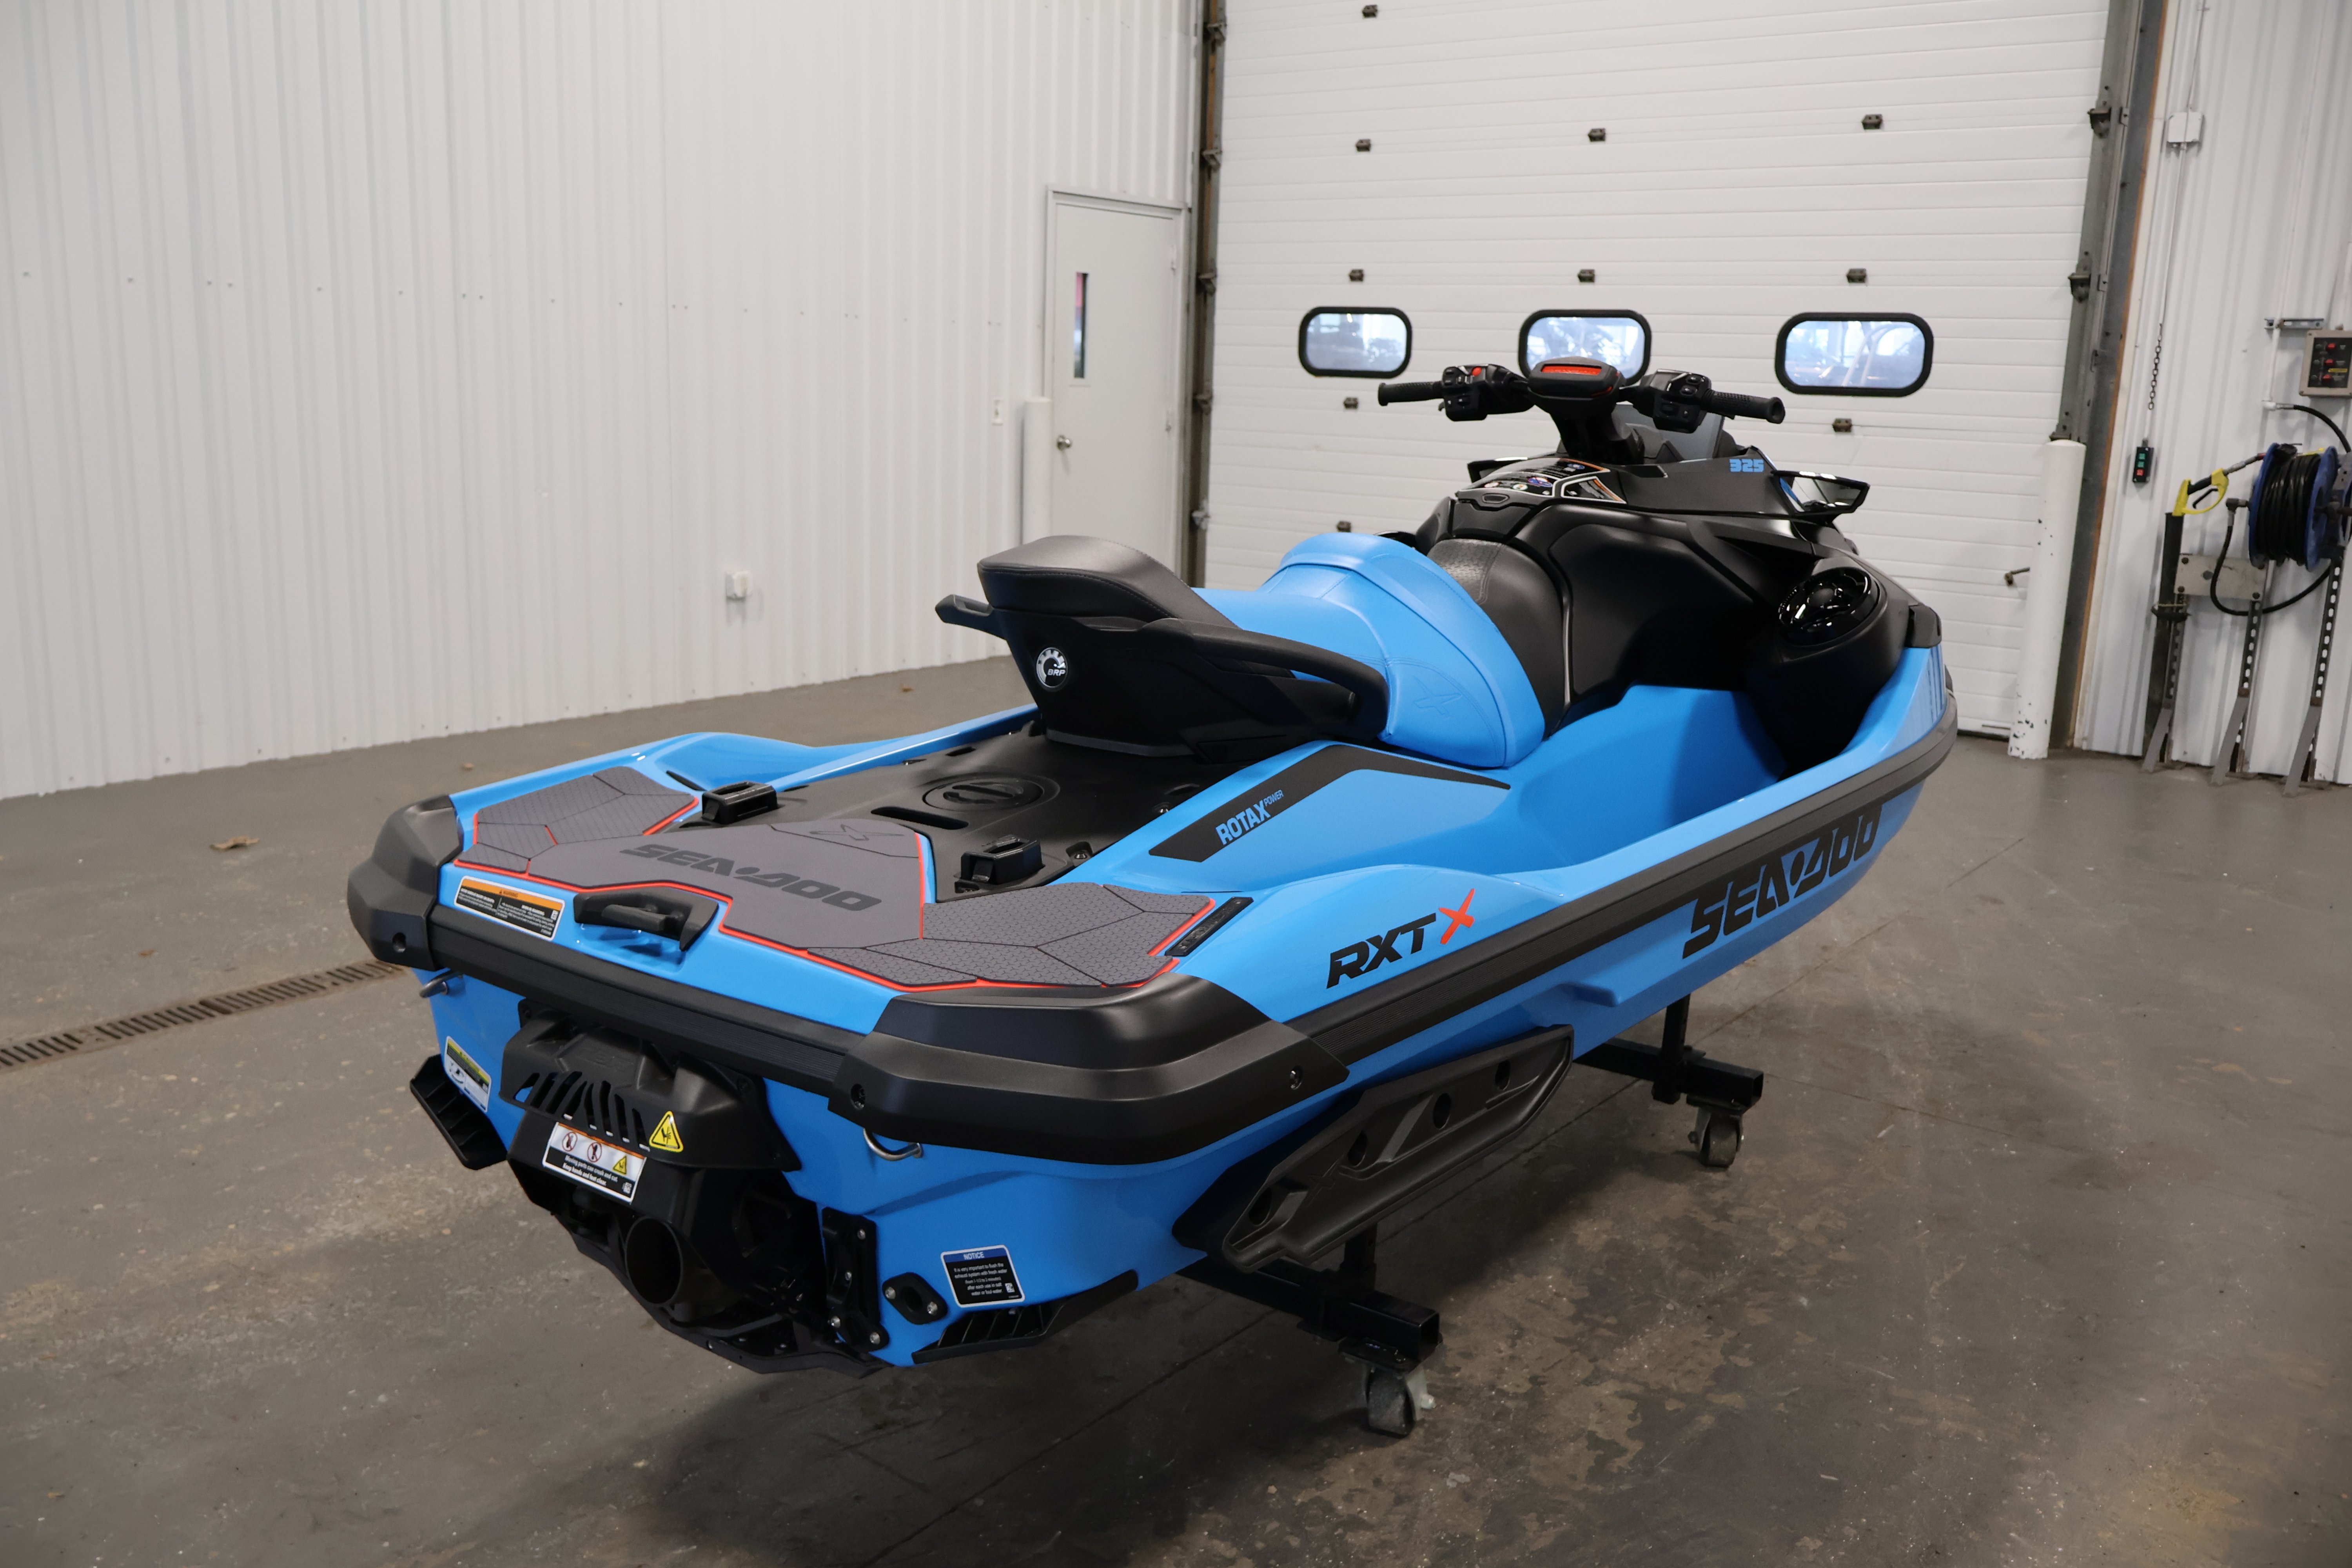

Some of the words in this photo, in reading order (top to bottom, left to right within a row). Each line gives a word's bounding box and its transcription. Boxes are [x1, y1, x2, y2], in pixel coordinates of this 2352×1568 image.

[1729, 458, 1764, 472] 325
[1047, 668, 1066, 677] BRP
[1215, 800, 1271, 845] ROTAX
[1264, 789, 1284, 807] POWER
[1326, 912, 1437, 989] RXT
[1438, 888, 1475, 945] X
[963, 1252, 985, 1260] NOTICE
